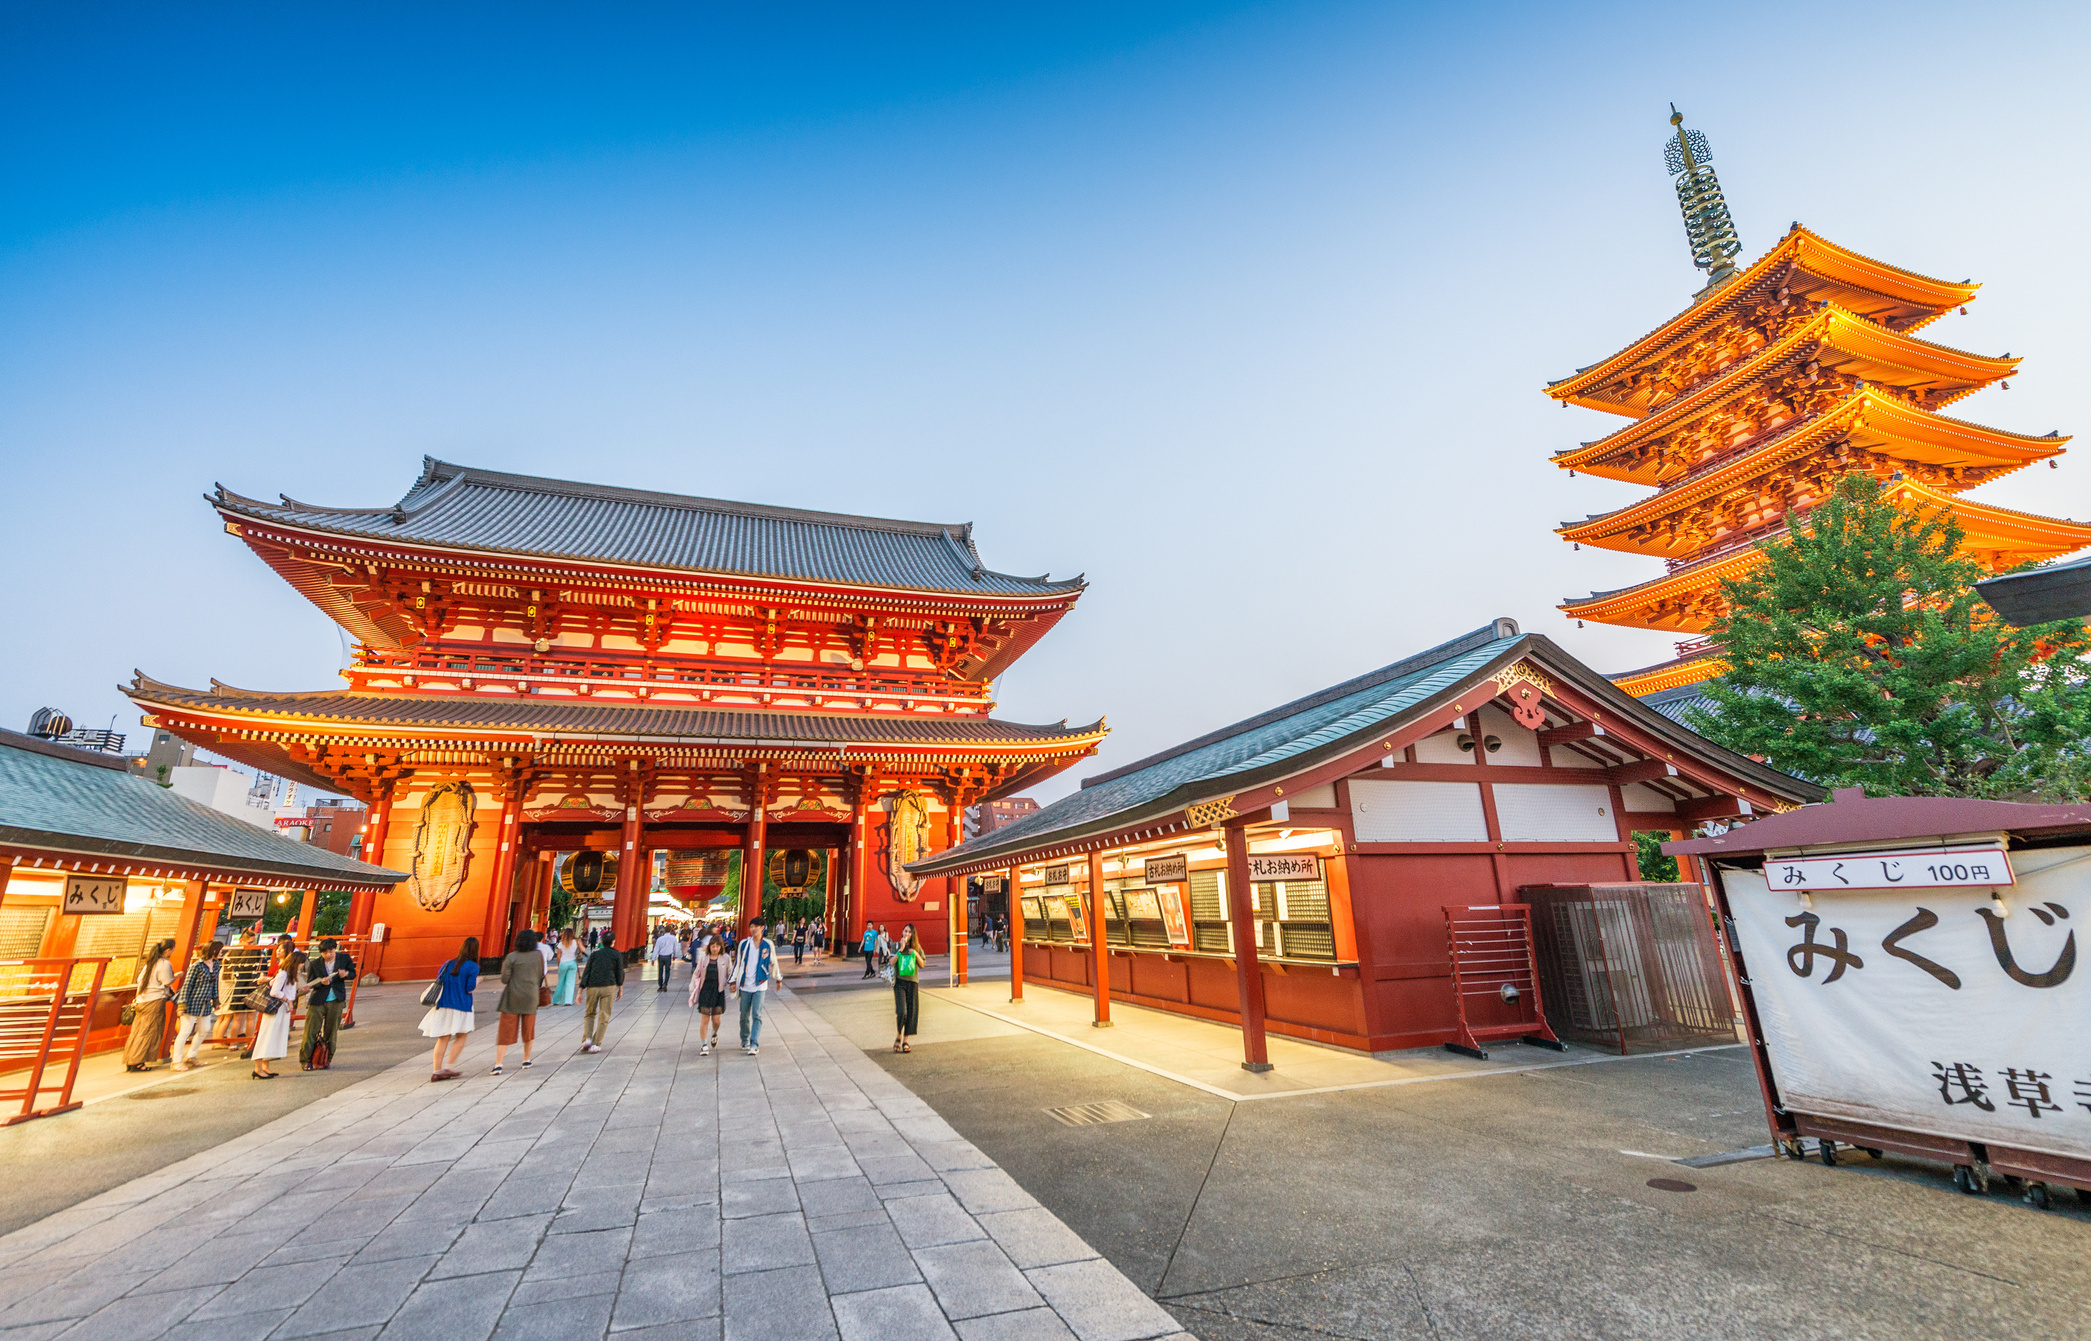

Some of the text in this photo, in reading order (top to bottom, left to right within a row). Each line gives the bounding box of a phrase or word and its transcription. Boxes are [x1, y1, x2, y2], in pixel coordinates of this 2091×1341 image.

[1783, 861, 1990, 885] みくじ 100円
[70, 884, 119, 904] みくじ
[235, 895, 263, 911] みくじ
[1785, 902, 2077, 989] みくじ
[1931, 1061, 2091, 1118] 浅草
